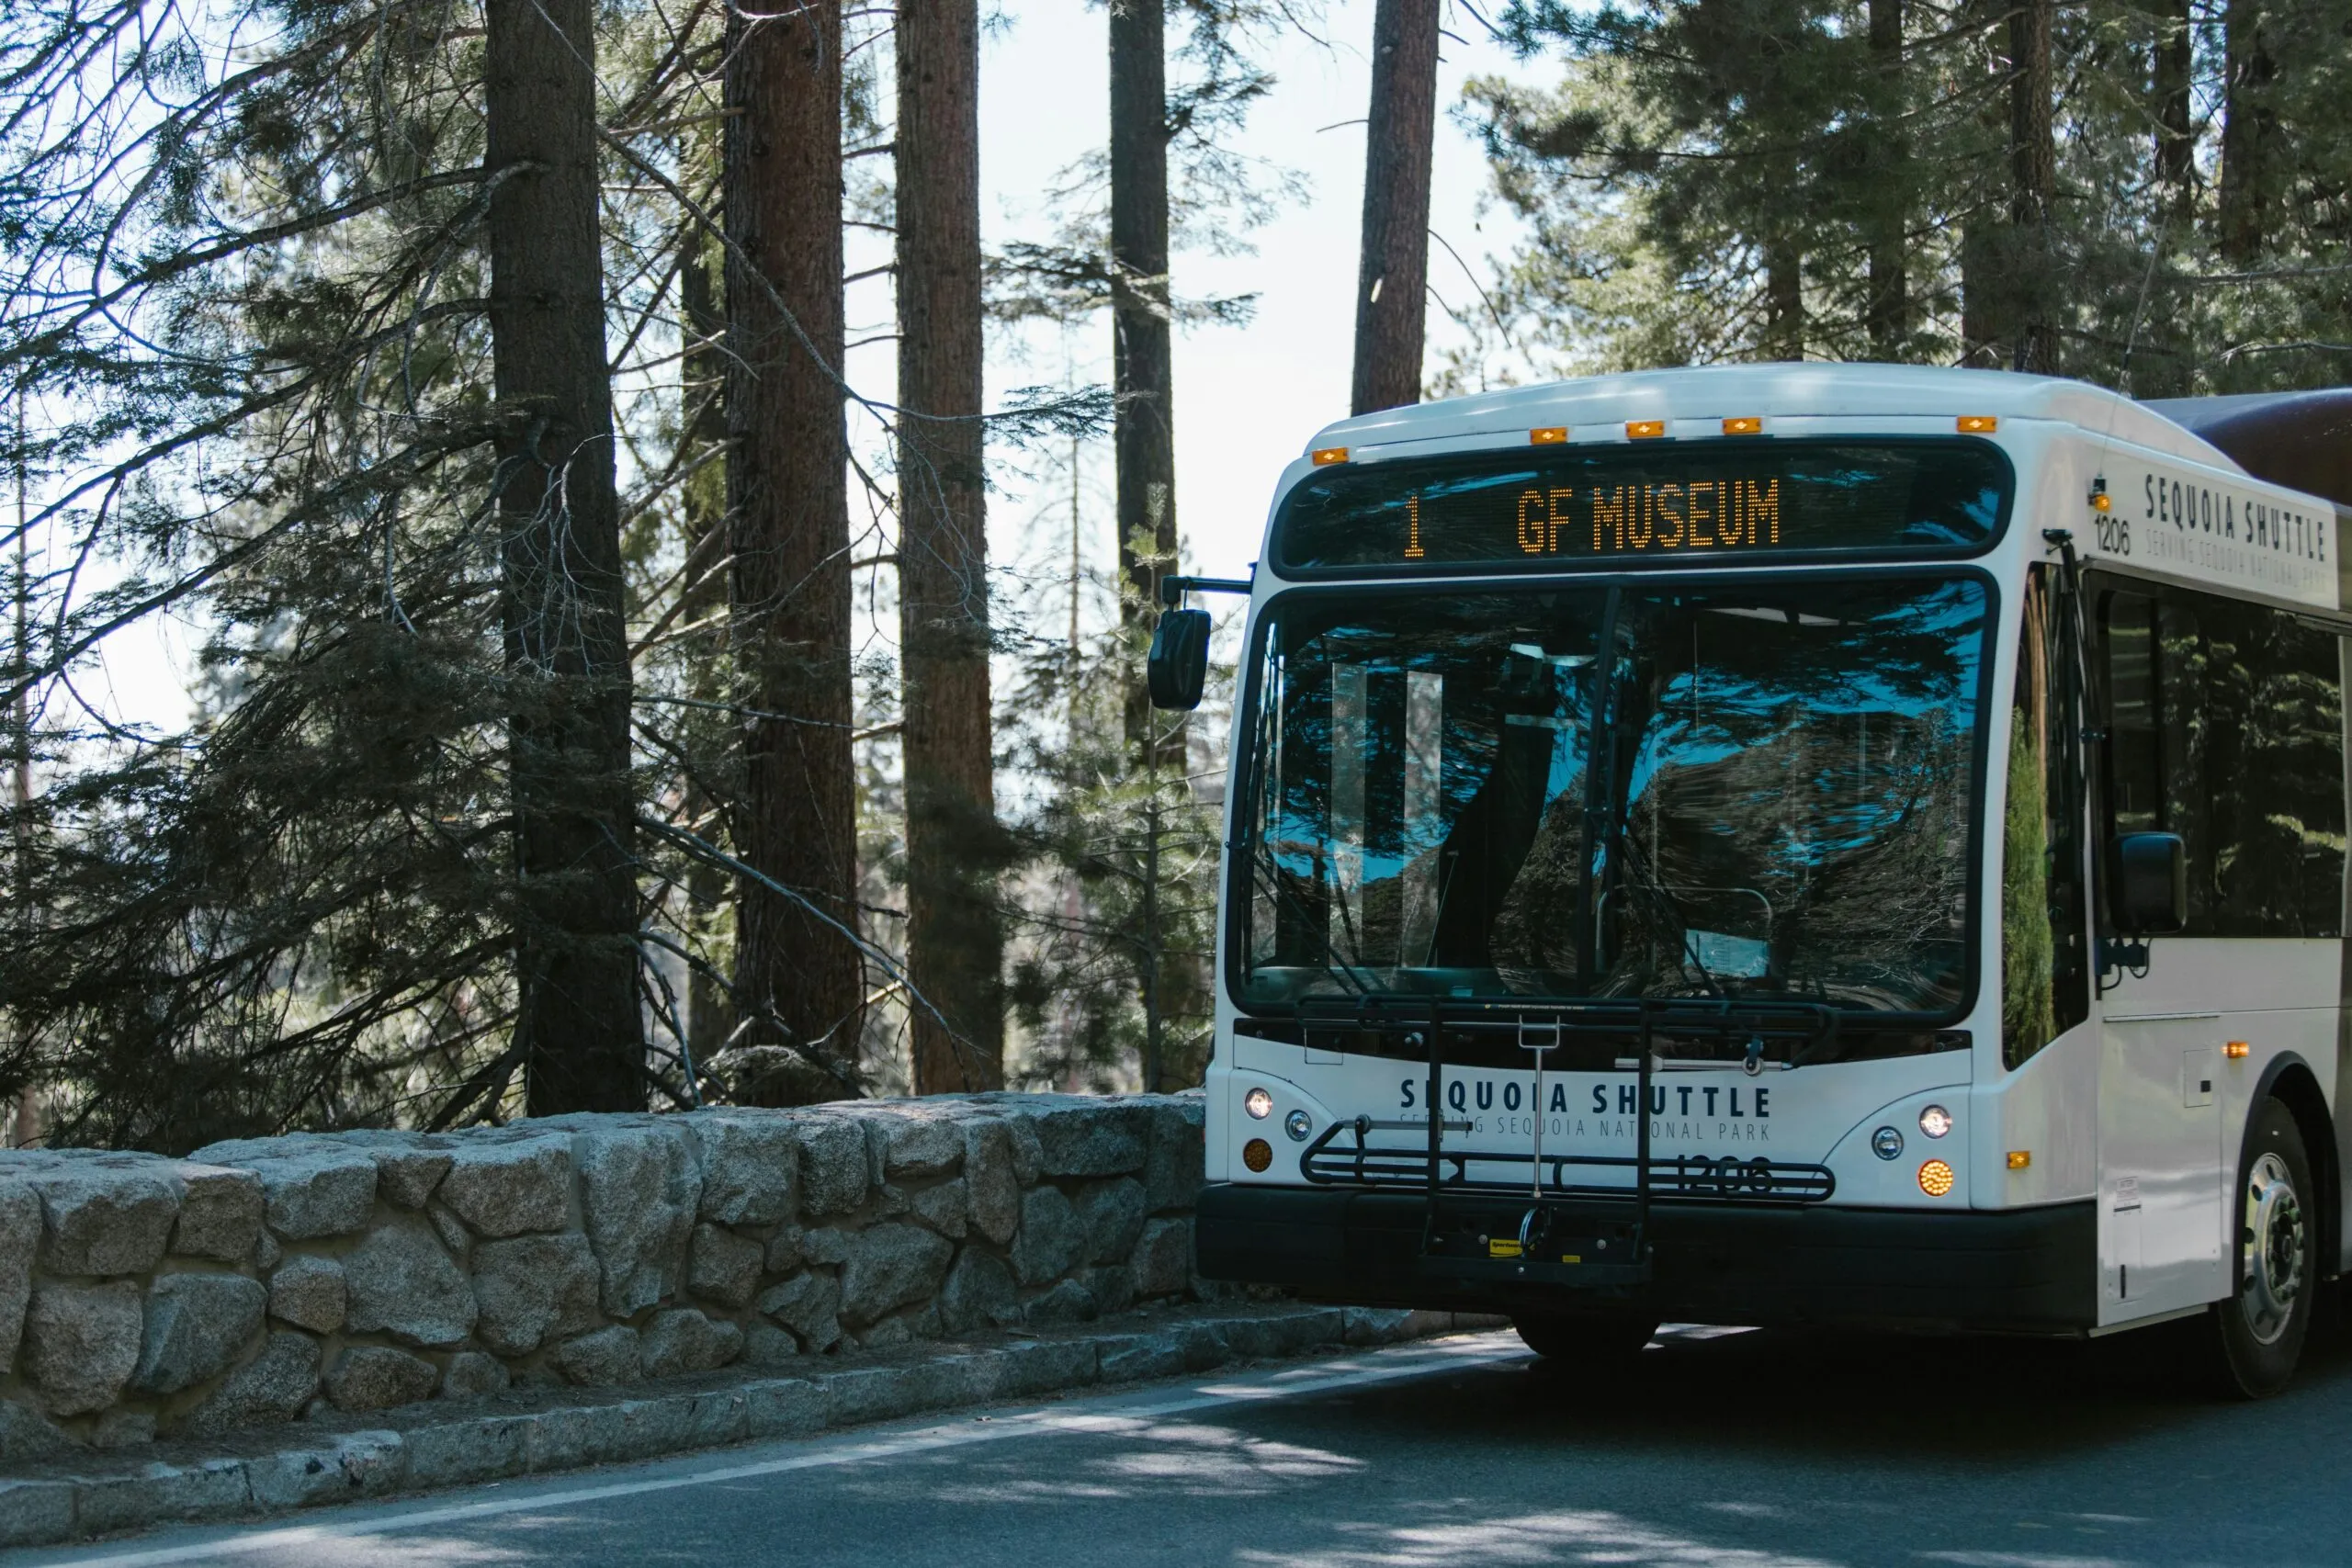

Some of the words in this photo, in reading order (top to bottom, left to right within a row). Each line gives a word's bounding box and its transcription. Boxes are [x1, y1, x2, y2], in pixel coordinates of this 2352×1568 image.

[1404, 495, 1424, 558] 1
[1518, 489, 1572, 553] GF
[1593, 479, 1779, 550] MUSEUM
[2094, 513, 2130, 556] 1206
[2145, 473, 2234, 539] SEQUOIA
[2245, 501, 2324, 562] SHUTTLE
[1592, 1084, 1770, 1118] SHUTTLE
[1600, 1120, 1703, 1140] NATONAL
[1719, 1122, 1770, 1141] PARK
